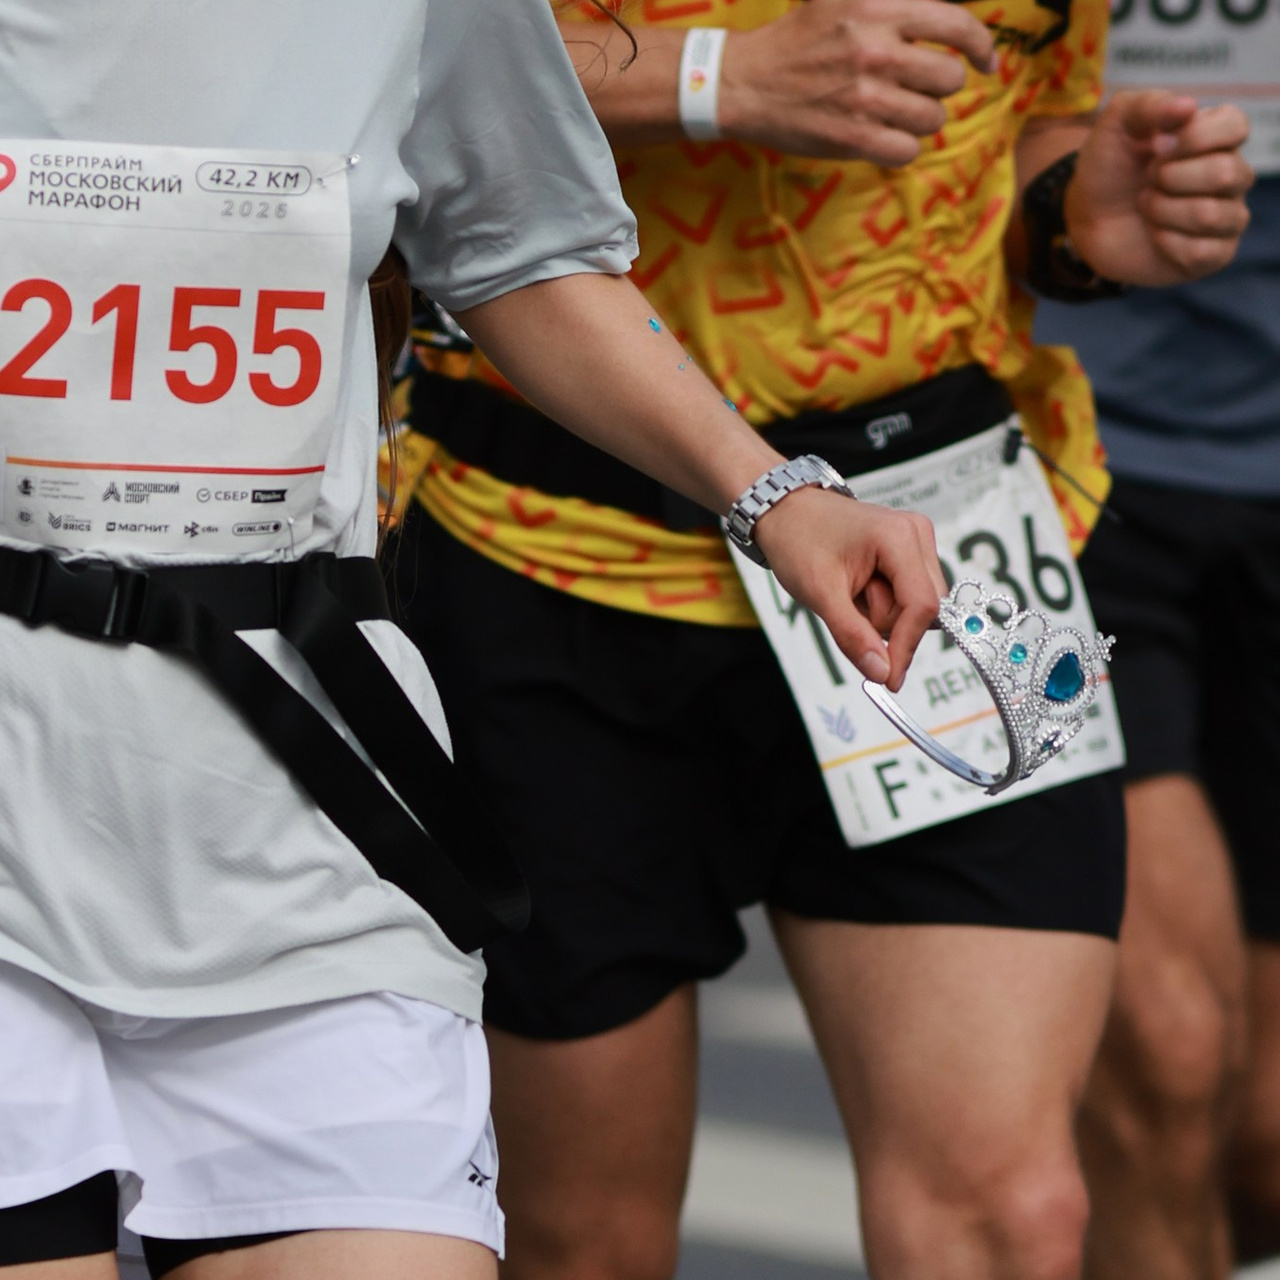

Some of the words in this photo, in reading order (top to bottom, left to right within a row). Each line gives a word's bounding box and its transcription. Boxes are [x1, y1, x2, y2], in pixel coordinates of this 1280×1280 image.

[29, 153, 143, 171] СБЕРПРАЙМ
[28, 170, 183, 194] МОСКОВСКИЙ
[208, 168, 258, 189] 42,2
[266, 170, 301, 189] КМ
[27, 190, 142, 212] МАРАФОН
[125, 481, 180, 493] МОСКОВСКИЙ
[214, 490, 248, 501] СБЕР
[124, 493, 150, 504] СПОРТ
[62, 523, 91, 532] BRICS
[786, 515, 1075, 687] 136
[873, 758, 909, 820] F
